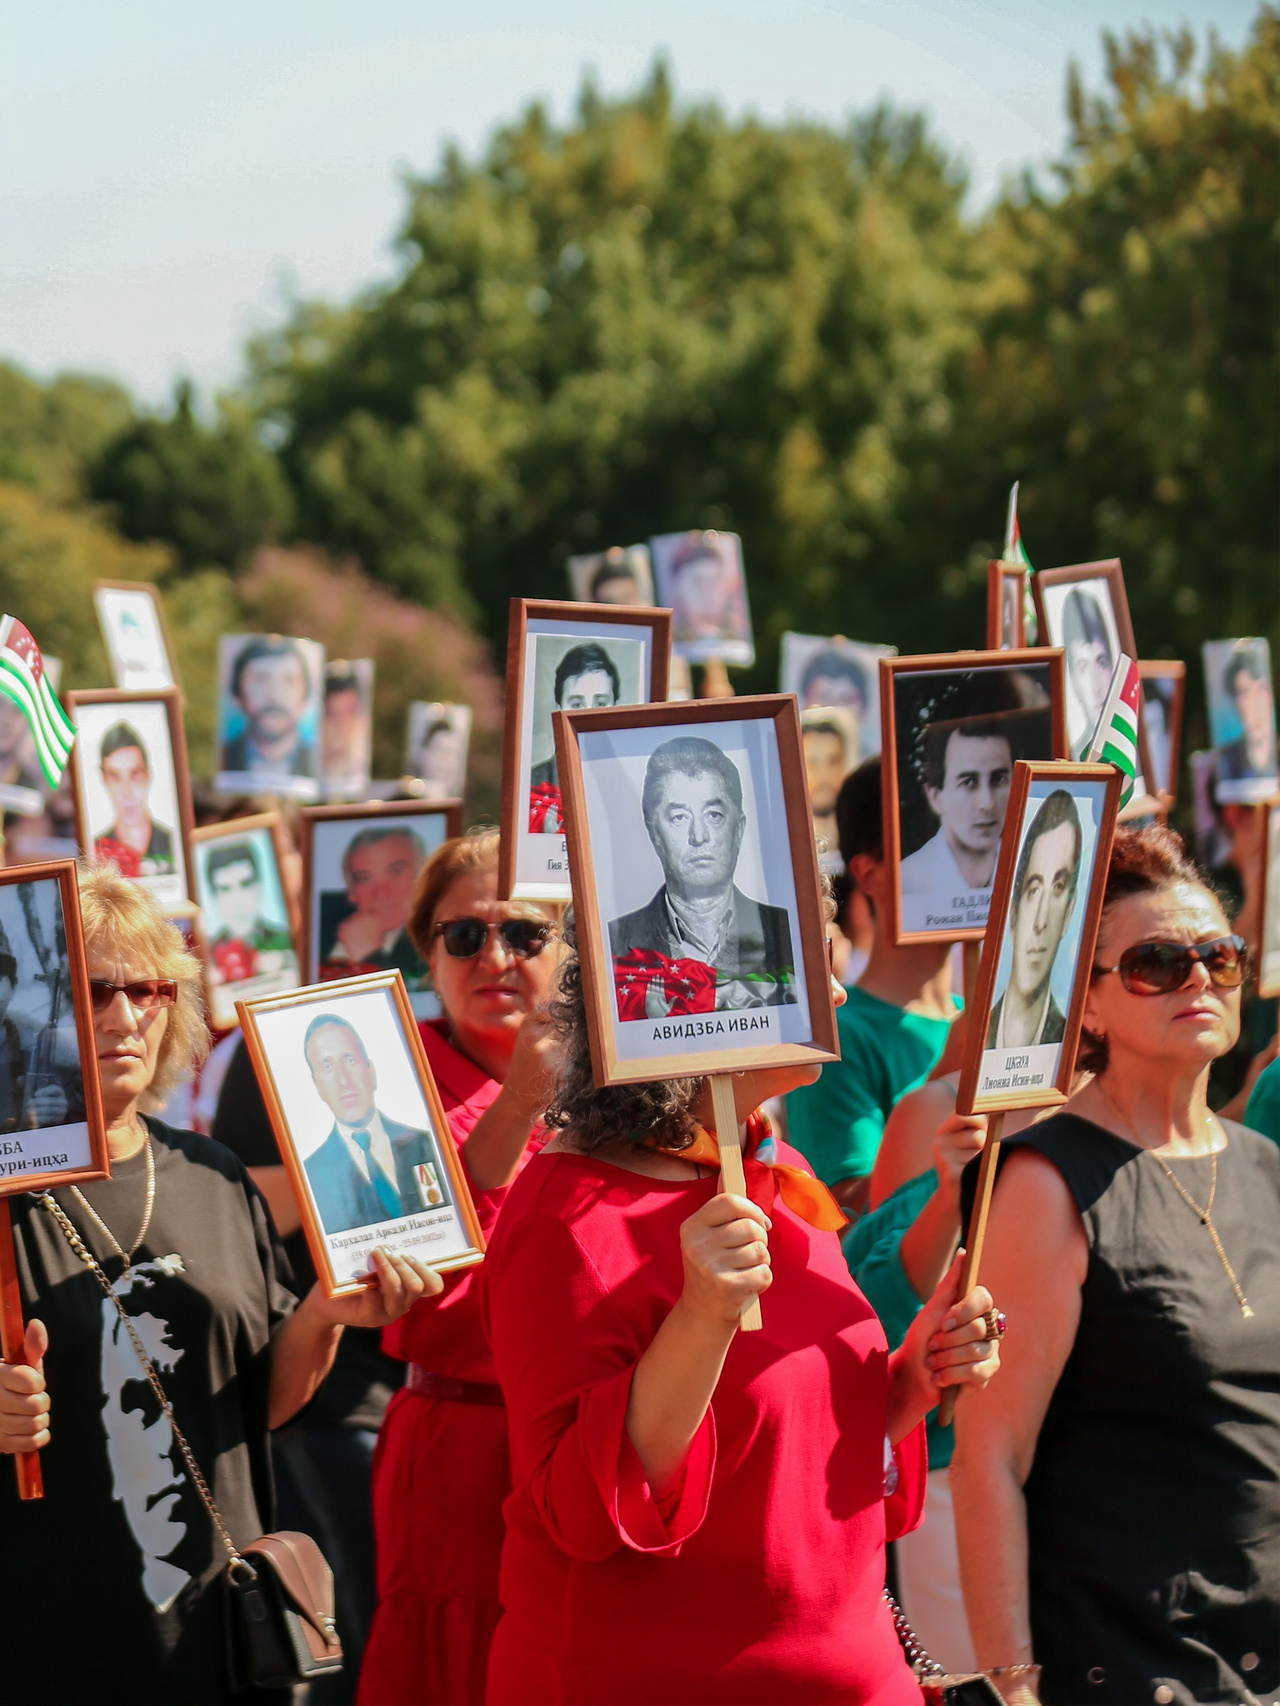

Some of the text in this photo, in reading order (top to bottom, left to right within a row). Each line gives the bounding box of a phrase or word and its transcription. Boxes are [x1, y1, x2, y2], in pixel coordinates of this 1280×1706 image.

[547, 858, 563, 870] Гия
[652, 1015, 770, 1040] АВИДЗБА ИВАН
